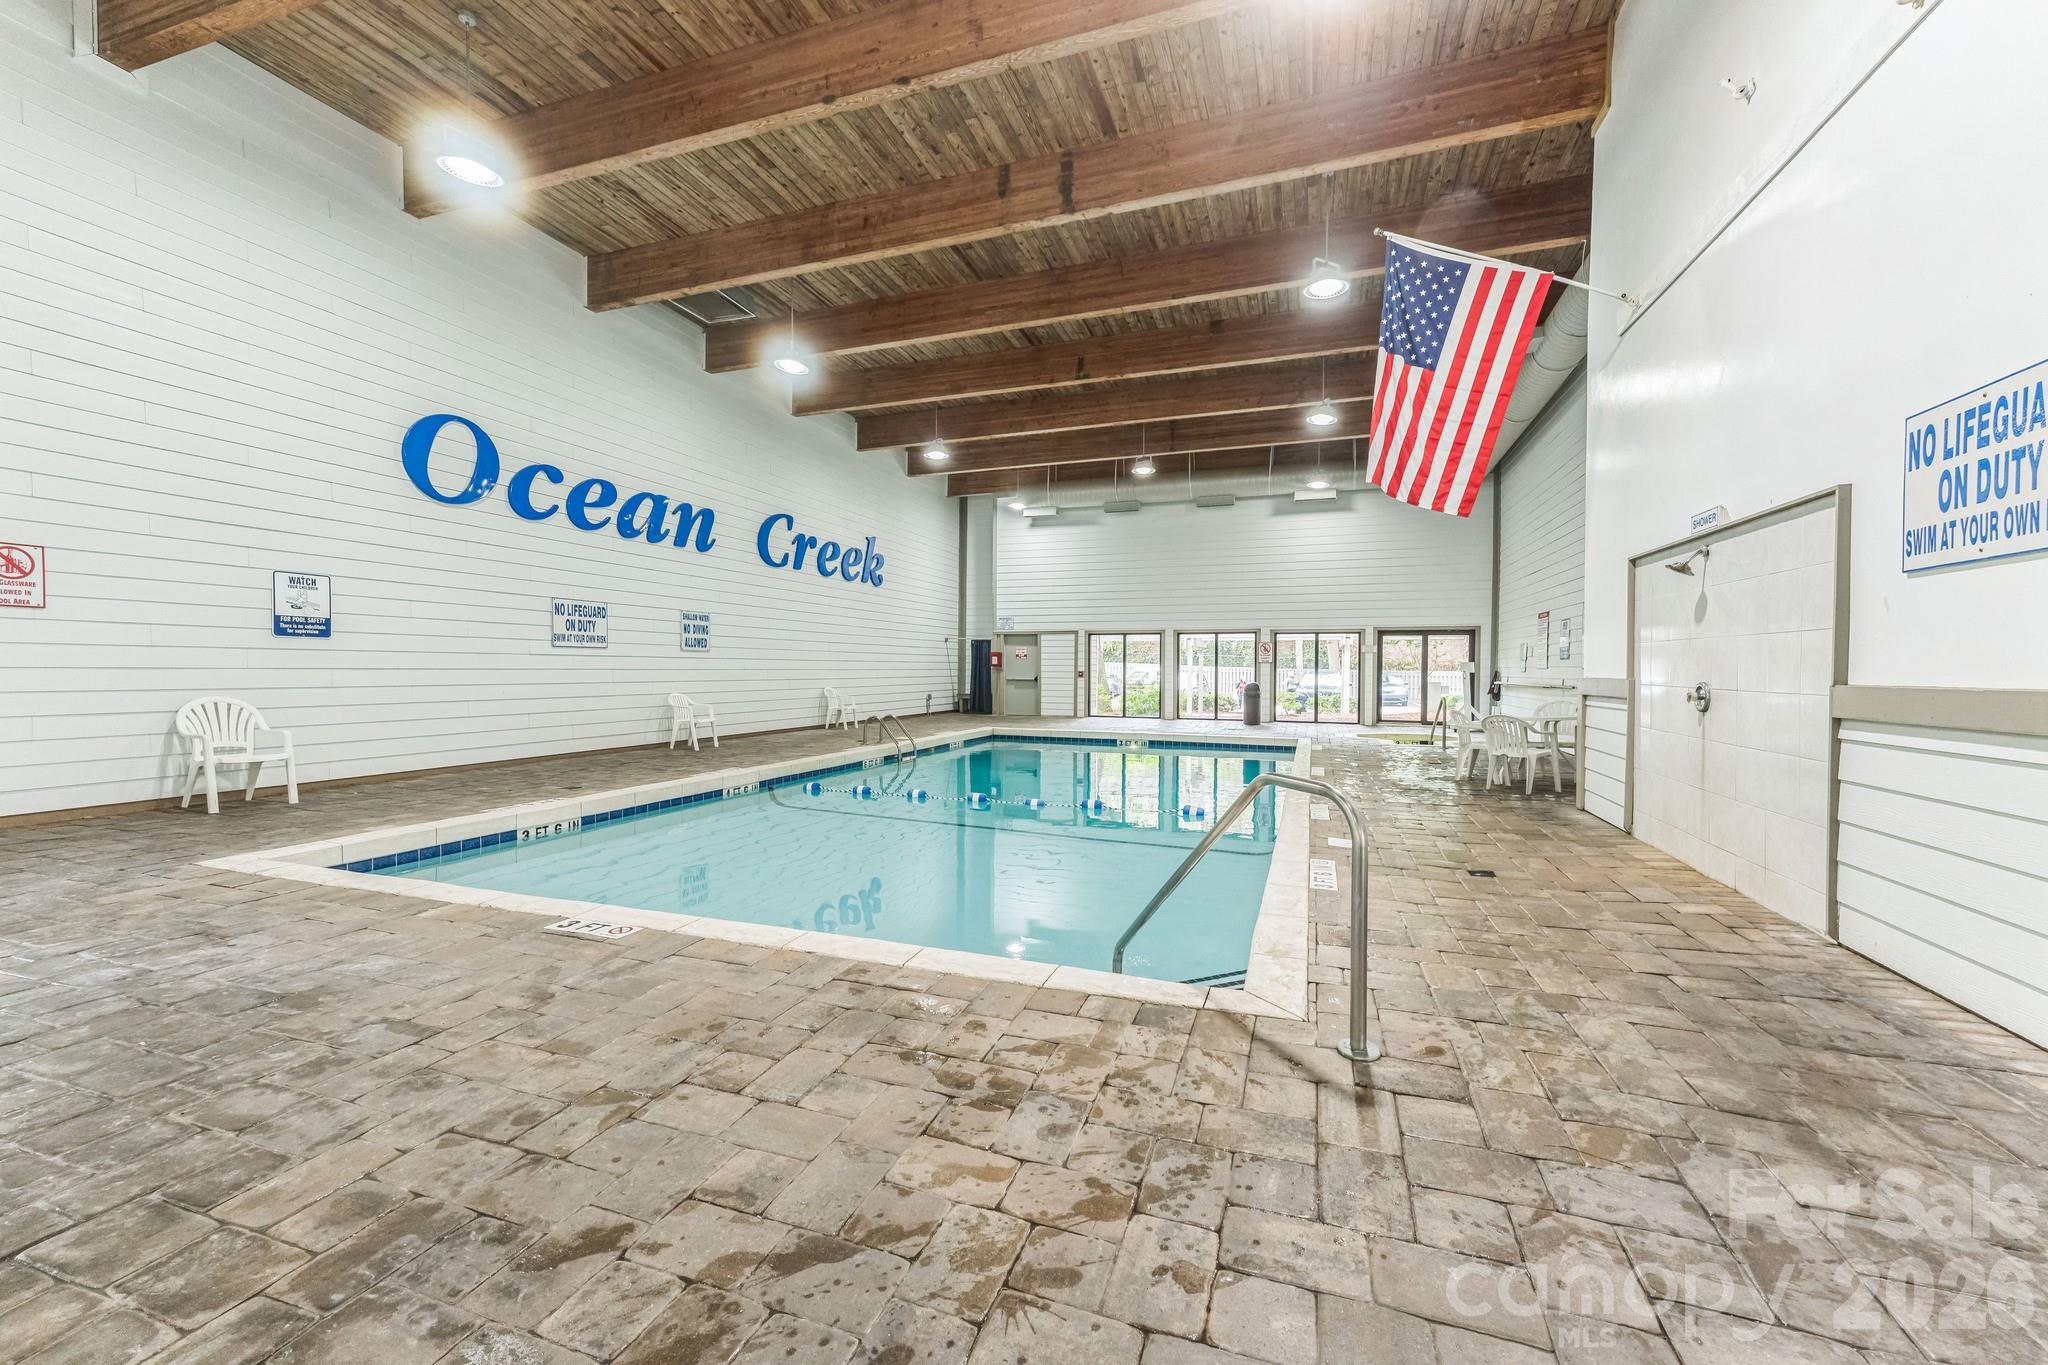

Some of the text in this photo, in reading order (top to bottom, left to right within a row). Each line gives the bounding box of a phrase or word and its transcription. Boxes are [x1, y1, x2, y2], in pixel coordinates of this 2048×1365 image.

[1908, 380, 2047, 472] NO LIFEGUA
[1938, 439, 2045, 513] ON DUTY
[401, 413, 885, 587] Ocean Creek
[1692, 512, 1717, 530] SHOWER
[1906, 524, 1937, 557] SWIM
[1940, 519, 1957, 551] AT
[1960, 510, 1999, 547] YOUR
[2004, 500, 2041, 539] OWN
[288, 576, 317, 587] WATCH
[554, 602, 607, 619] NO LIFEGUARD
[565, 619, 597, 632] ON DUTY
[683, 623, 709, 635] NO DIVING
[553, 633, 607, 644] SWIM AT YOUR OWN RISK
[685, 636, 708, 649] ALLOWED
[522, 819, 579, 841] 3 FT 6 IN
[557, 920, 612, 932] 3 FT
